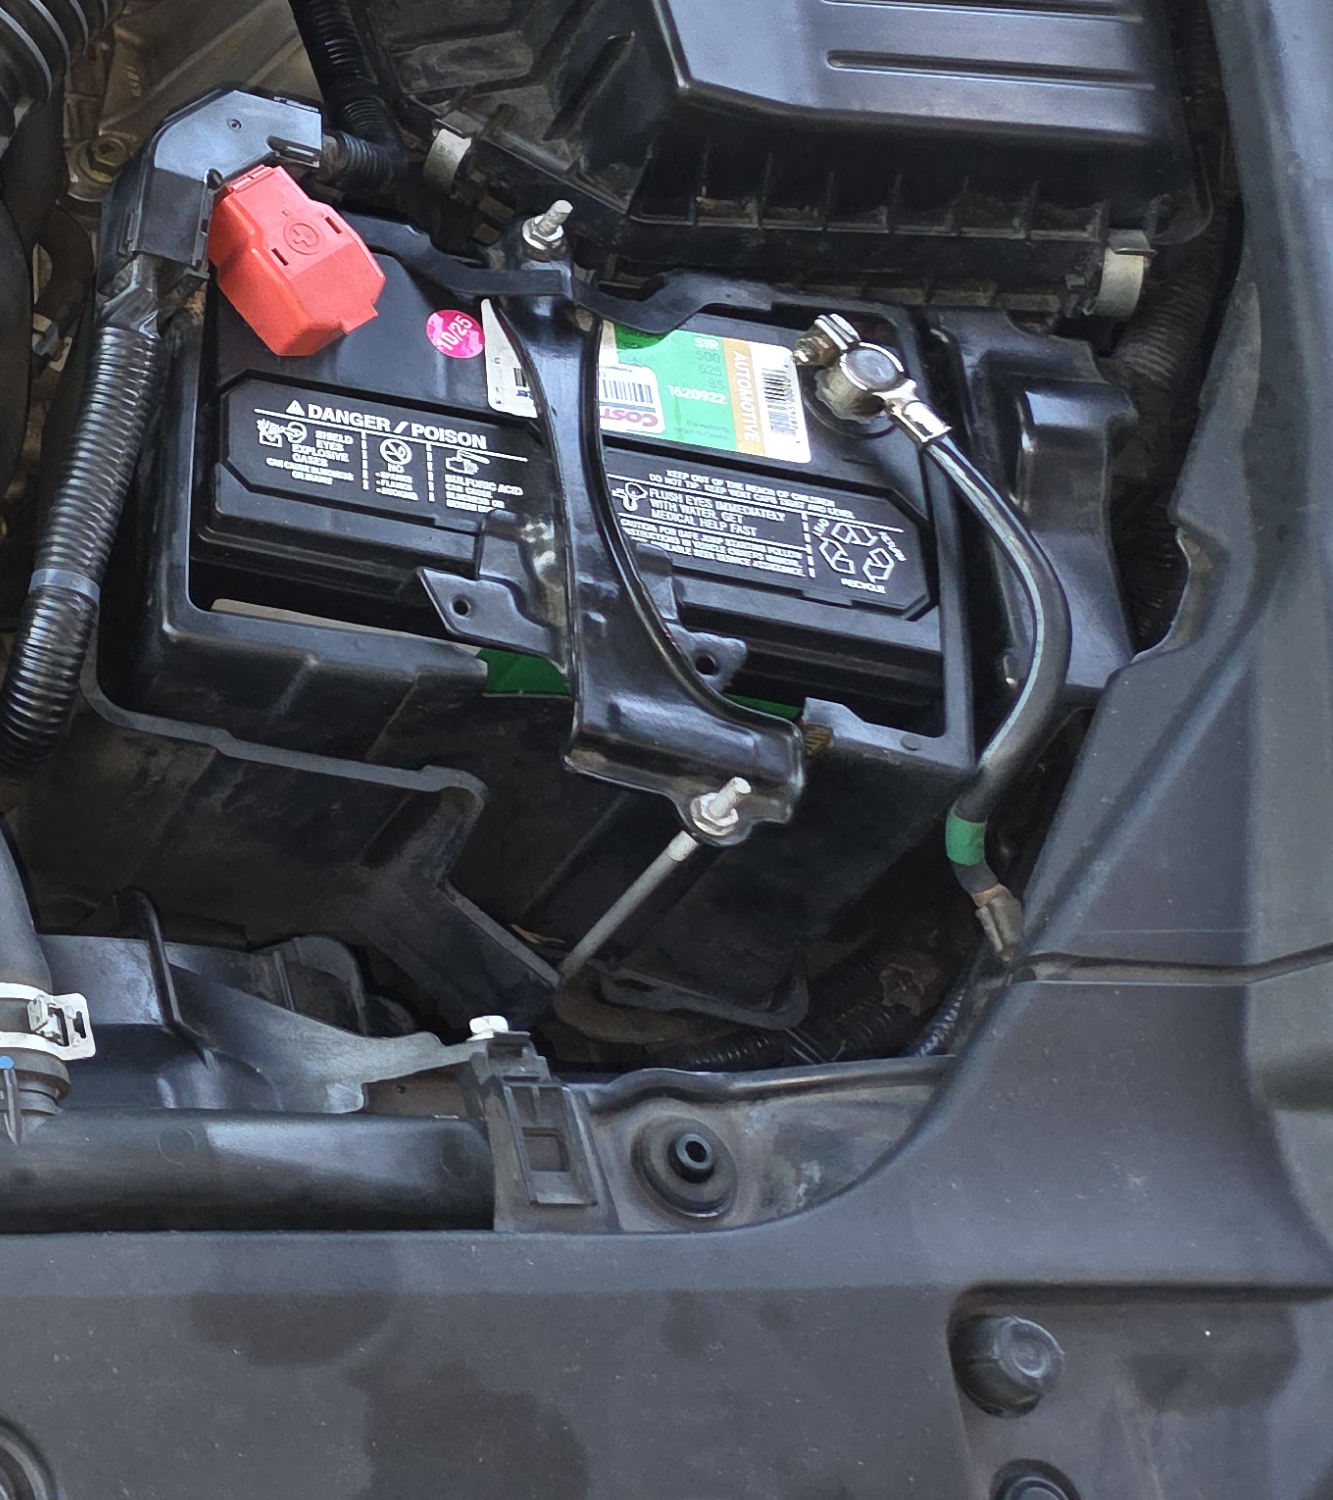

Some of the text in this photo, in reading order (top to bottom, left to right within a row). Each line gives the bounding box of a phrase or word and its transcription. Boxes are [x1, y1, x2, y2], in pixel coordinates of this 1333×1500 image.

[436, 314, 473, 351] 10/25
[694, 337, 720, 350] 51R
[696, 351, 720, 363] 500
[699, 365, 722, 377] 625
[667, 385, 727, 405] 1620922
[733, 351, 760, 444] AUTOMOTIVE
[308, 404, 391, 432] DANGER
[411, 424, 487, 450] POISON
[600, 408, 658, 427] COST
[315, 429, 354, 445] SHIELD
[315, 439, 345, 452] EYES
[291, 443, 350, 463] EXPLOSIVE
[292, 453, 329, 467] GASES
[388, 463, 404, 474] NO
[445, 474, 523, 495] SULFURIC ACID
[649, 488, 786, 522] FLUSH EYES IMMEDIATELY
[650, 498, 677, 512] WITH
[720, 511, 744, 524] GET
[651, 509, 758, 537] MEDICAL HELP FAST
[841, 578, 886, 594] RECYCLE
